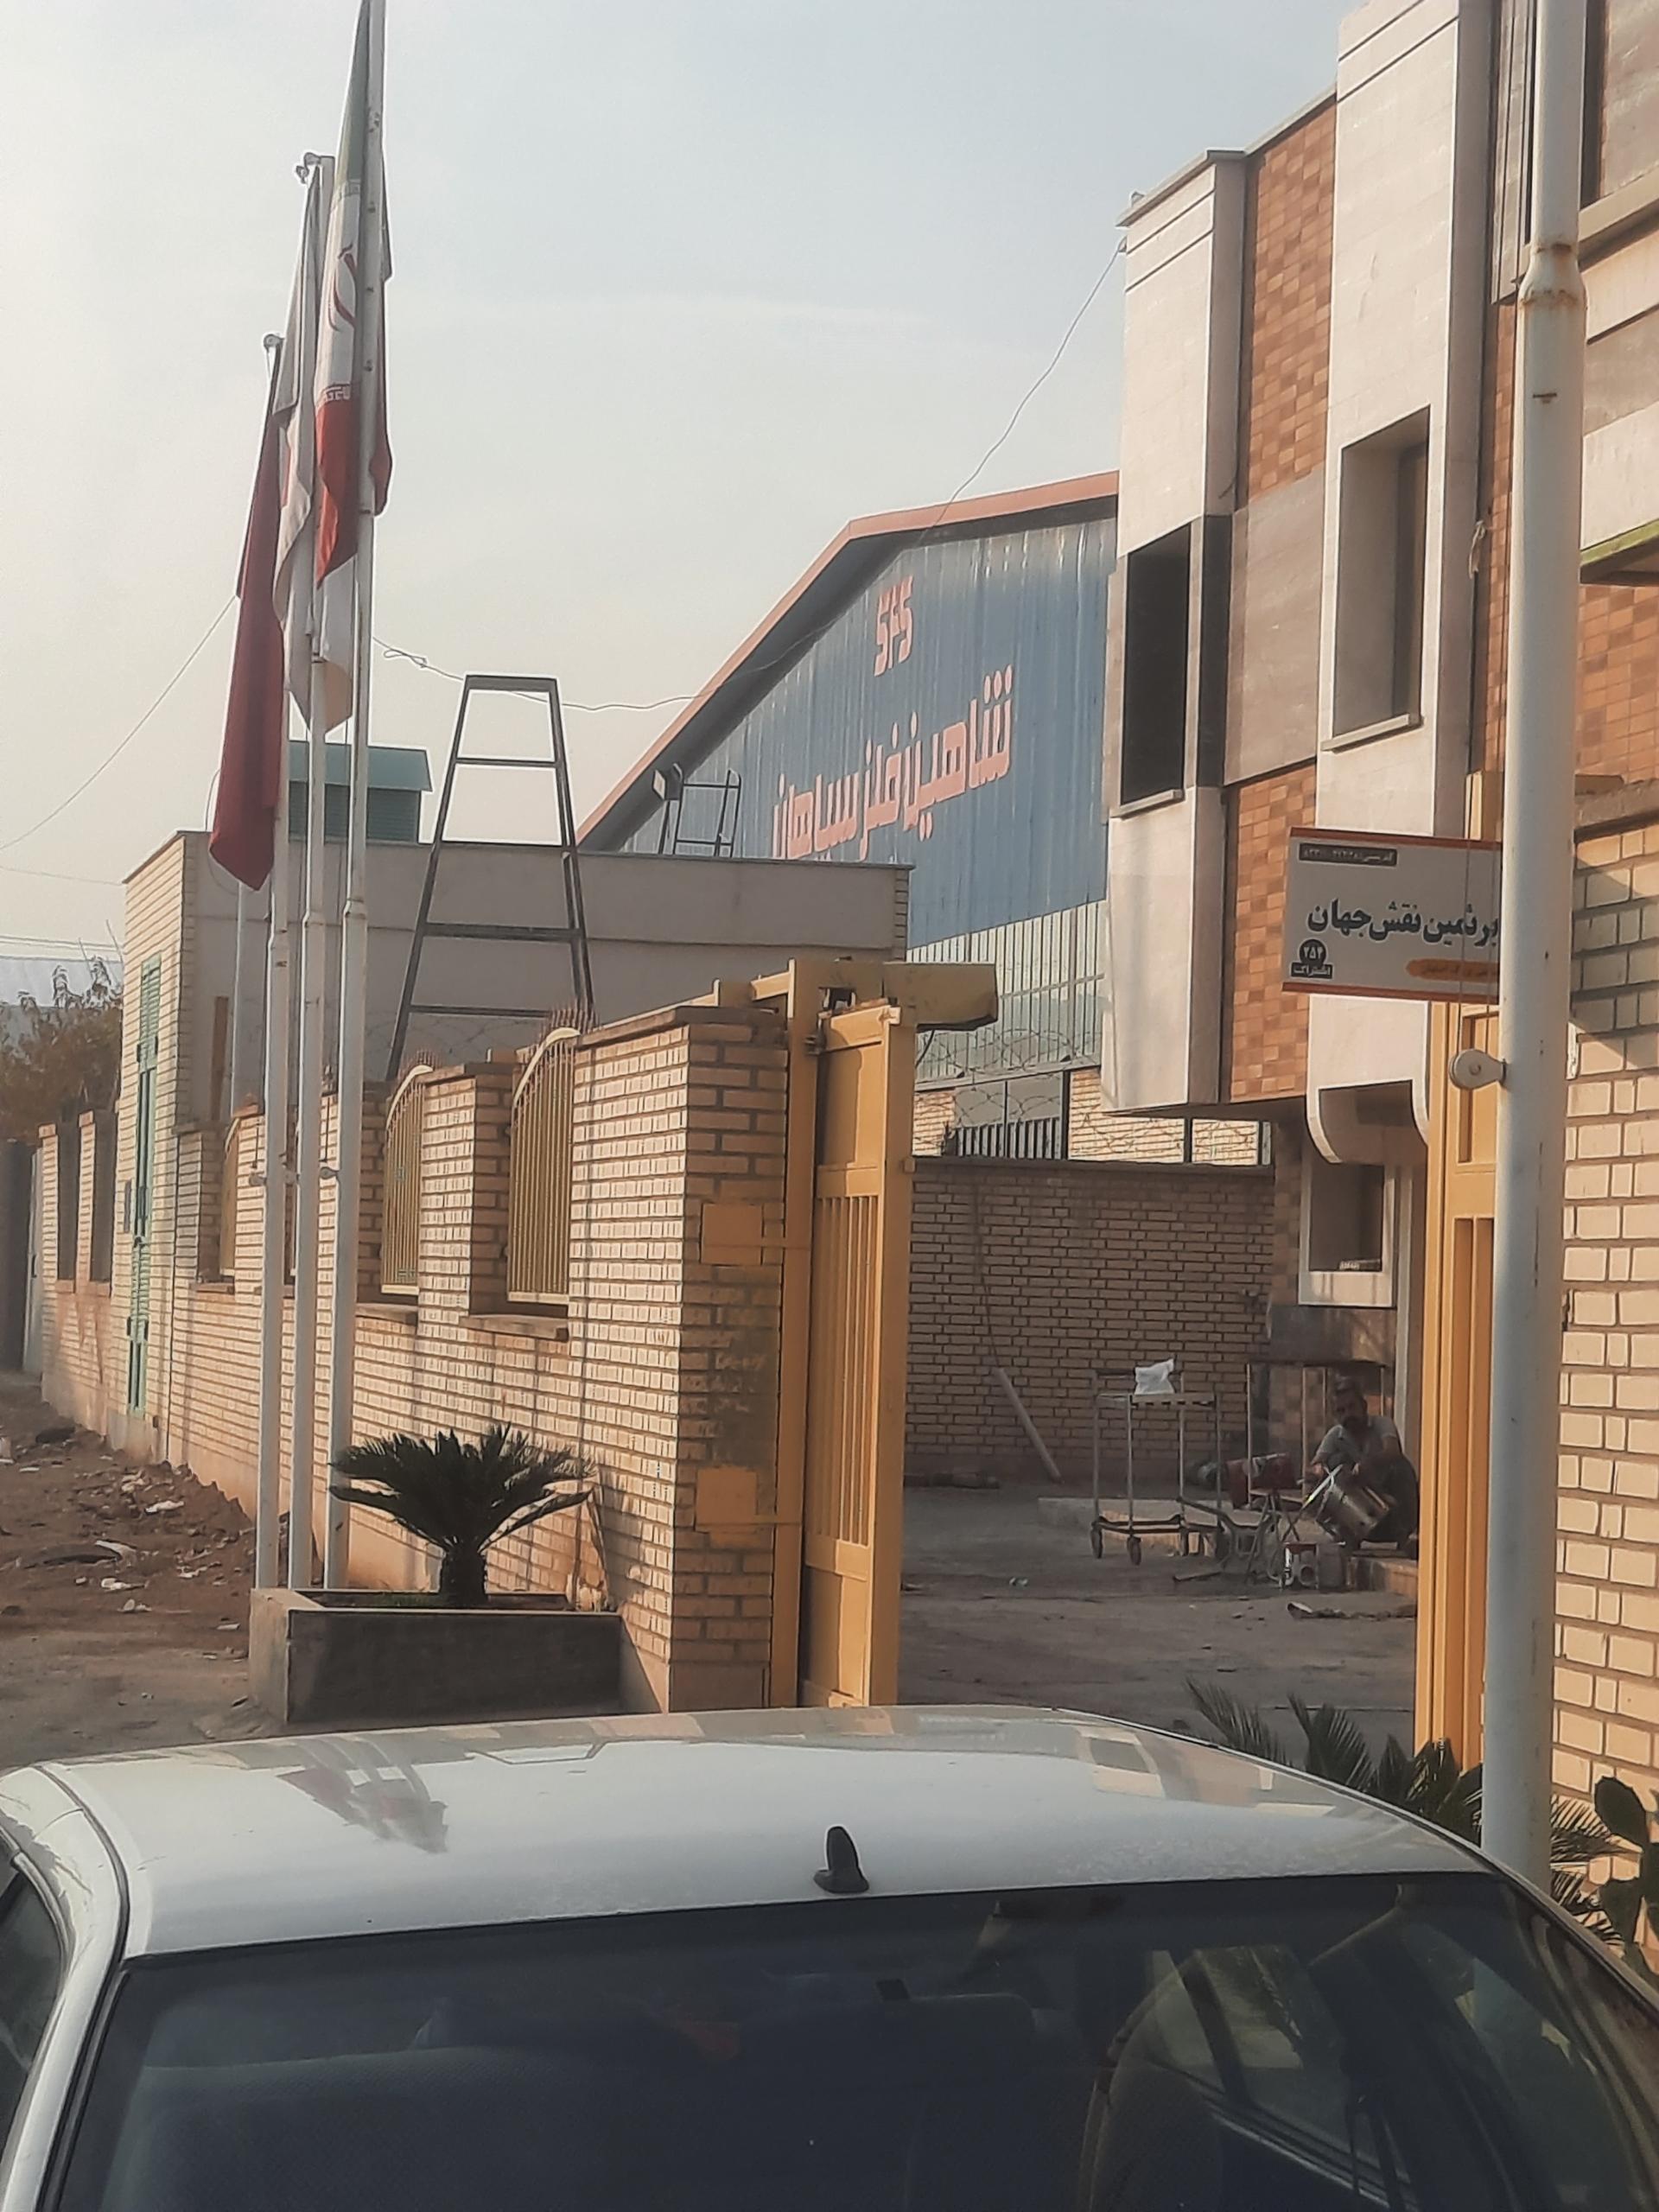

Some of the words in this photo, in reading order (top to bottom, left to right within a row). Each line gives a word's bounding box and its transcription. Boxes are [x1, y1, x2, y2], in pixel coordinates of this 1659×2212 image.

[859, 723, 901, 861] فلز
[904, 664, 1014, 842] شاهین
[1307, 898, 1370, 937] جهان
[1369, 900, 1421, 941] نقش
